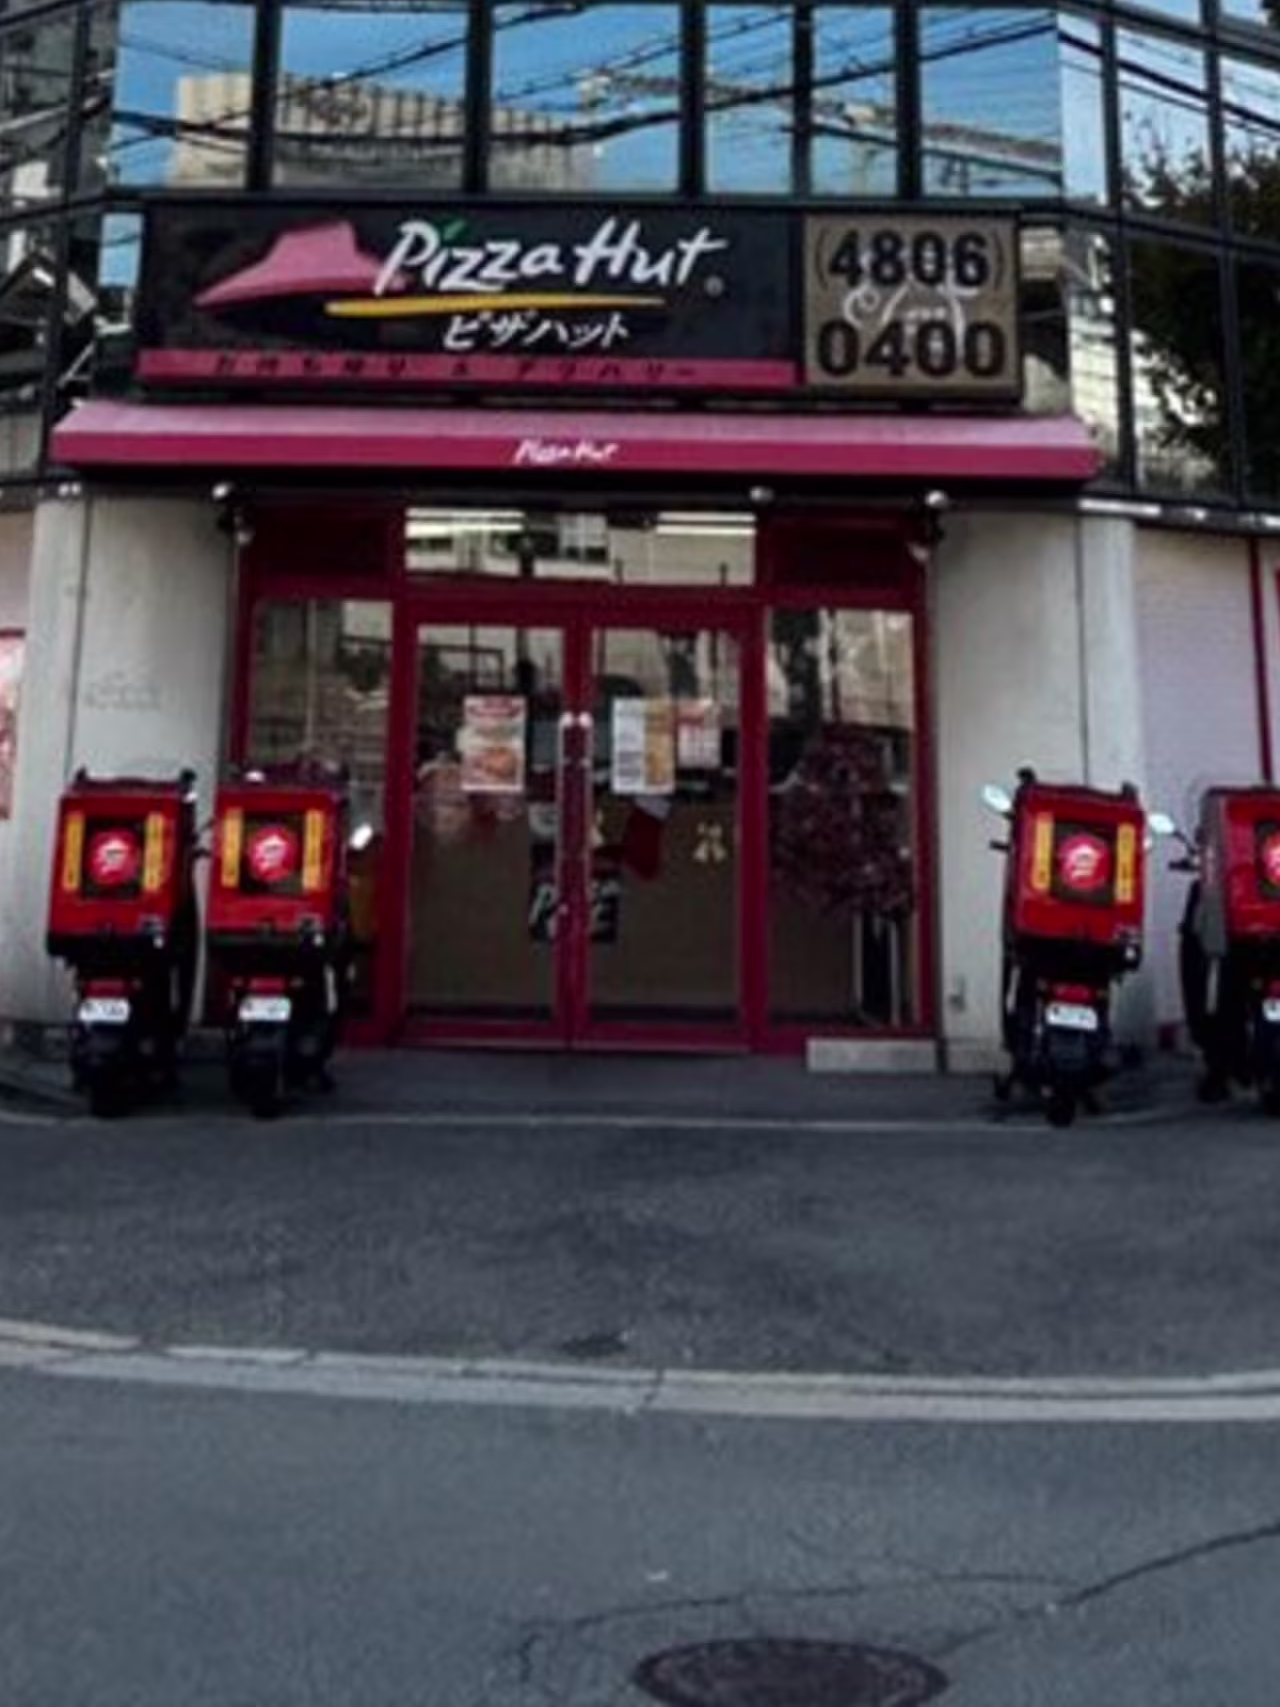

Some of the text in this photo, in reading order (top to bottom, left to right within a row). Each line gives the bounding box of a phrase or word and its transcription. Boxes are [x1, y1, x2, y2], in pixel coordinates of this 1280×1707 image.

[372, 216, 728, 296] Pizza Hut
[443, 309, 629, 350] ピザハット
[817, 319, 1007, 380] 0400
